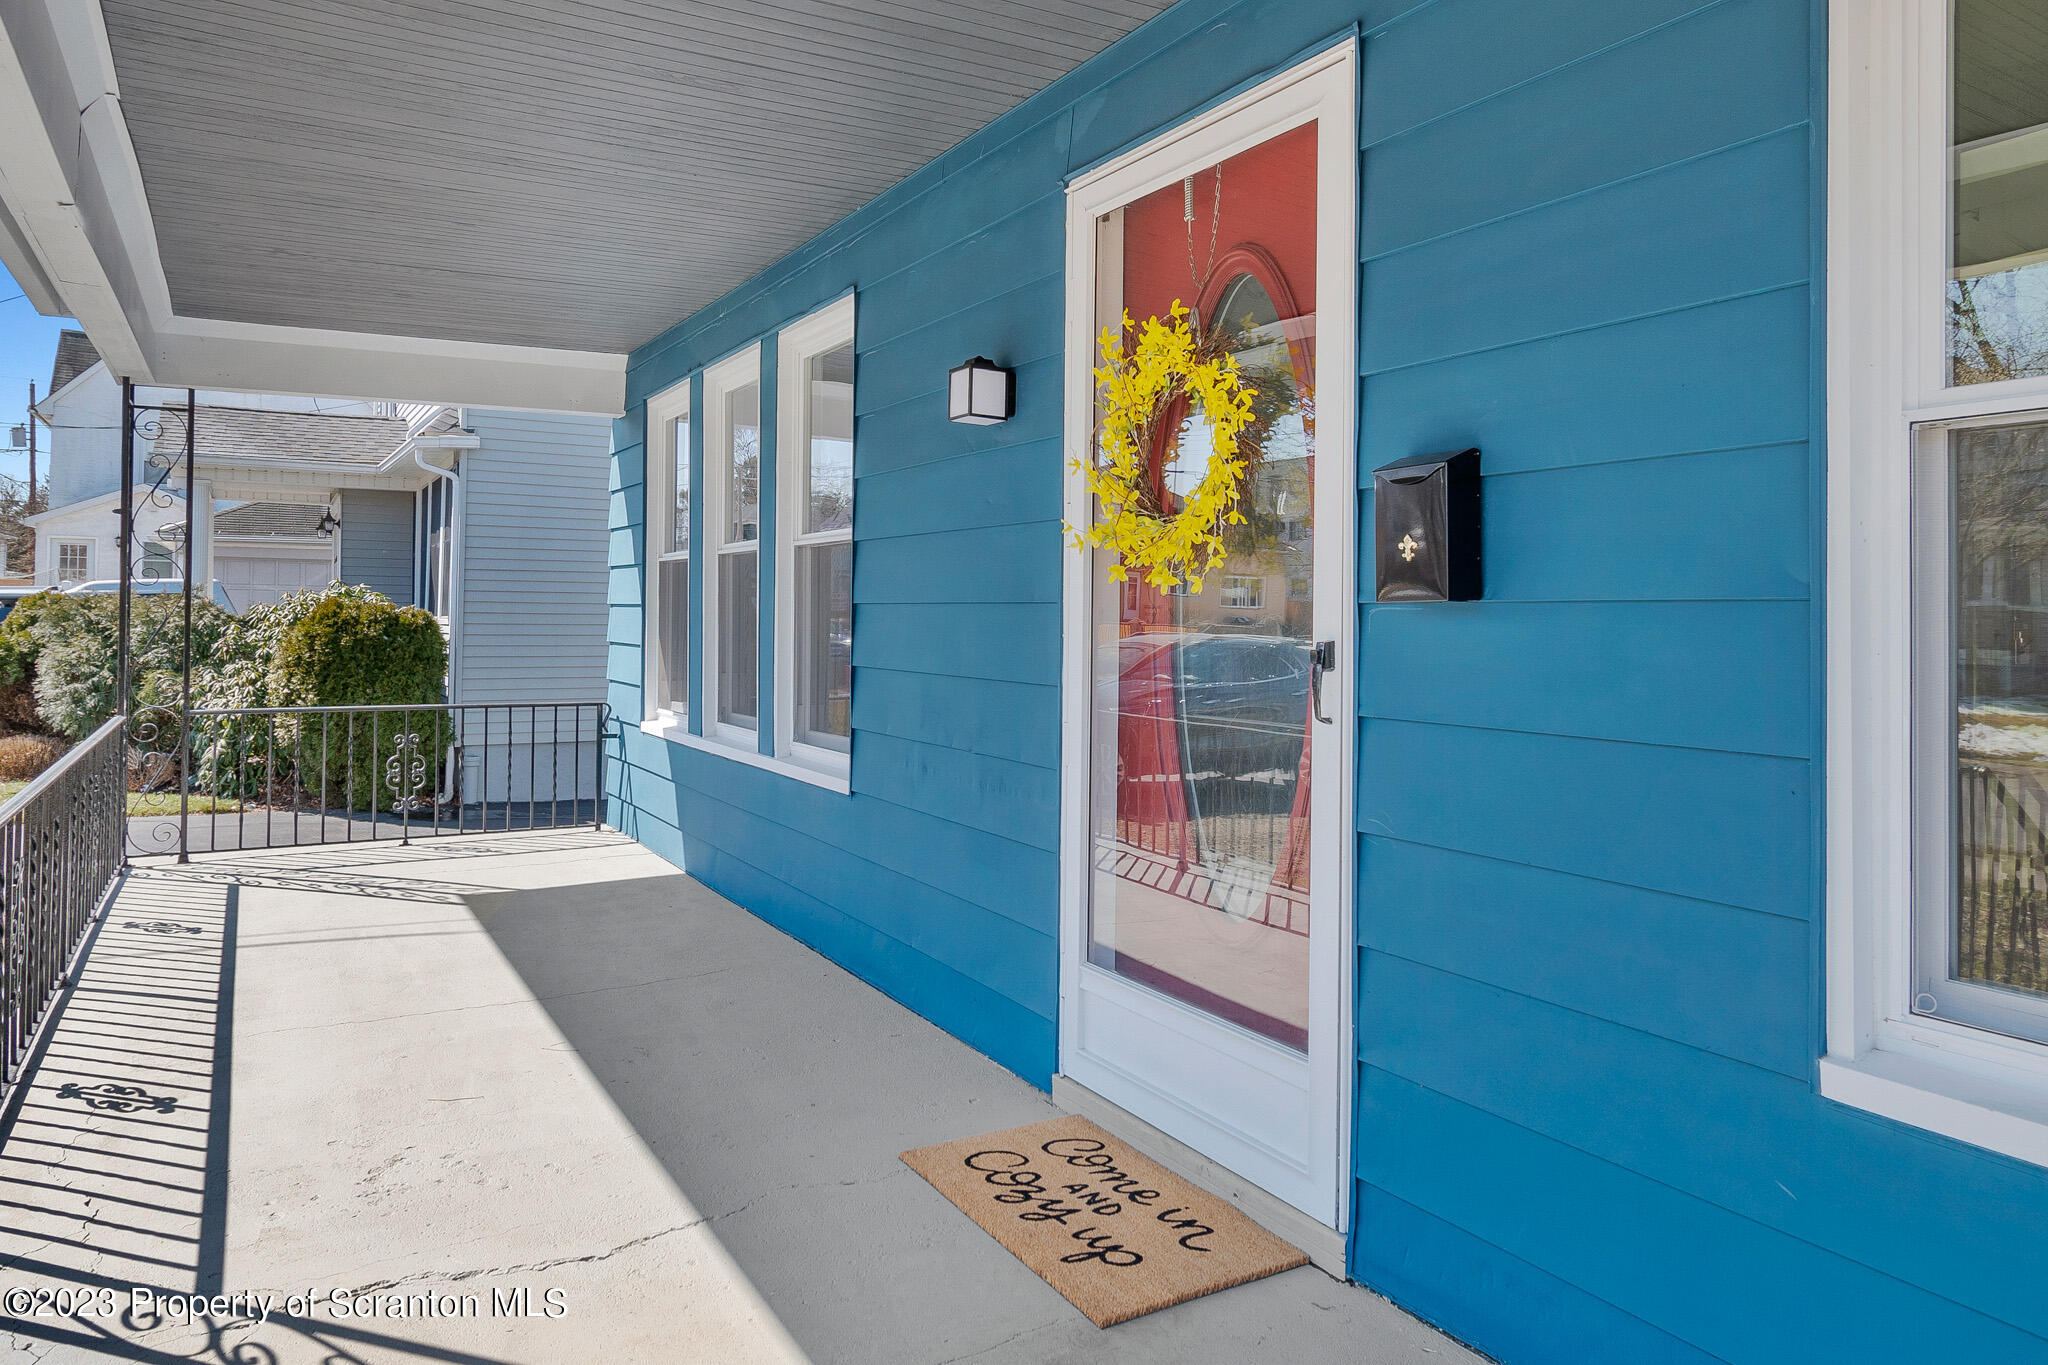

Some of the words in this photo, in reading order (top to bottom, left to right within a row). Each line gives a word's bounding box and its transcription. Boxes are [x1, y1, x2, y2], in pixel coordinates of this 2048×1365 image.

[964, 1150, 1081, 1225] Cozy
[1060, 1227, 1144, 1267] up
[1041, 1138, 1160, 1206] Come
[1157, 1206, 1214, 1252] in
[1062, 1184, 1122, 1216] AND
